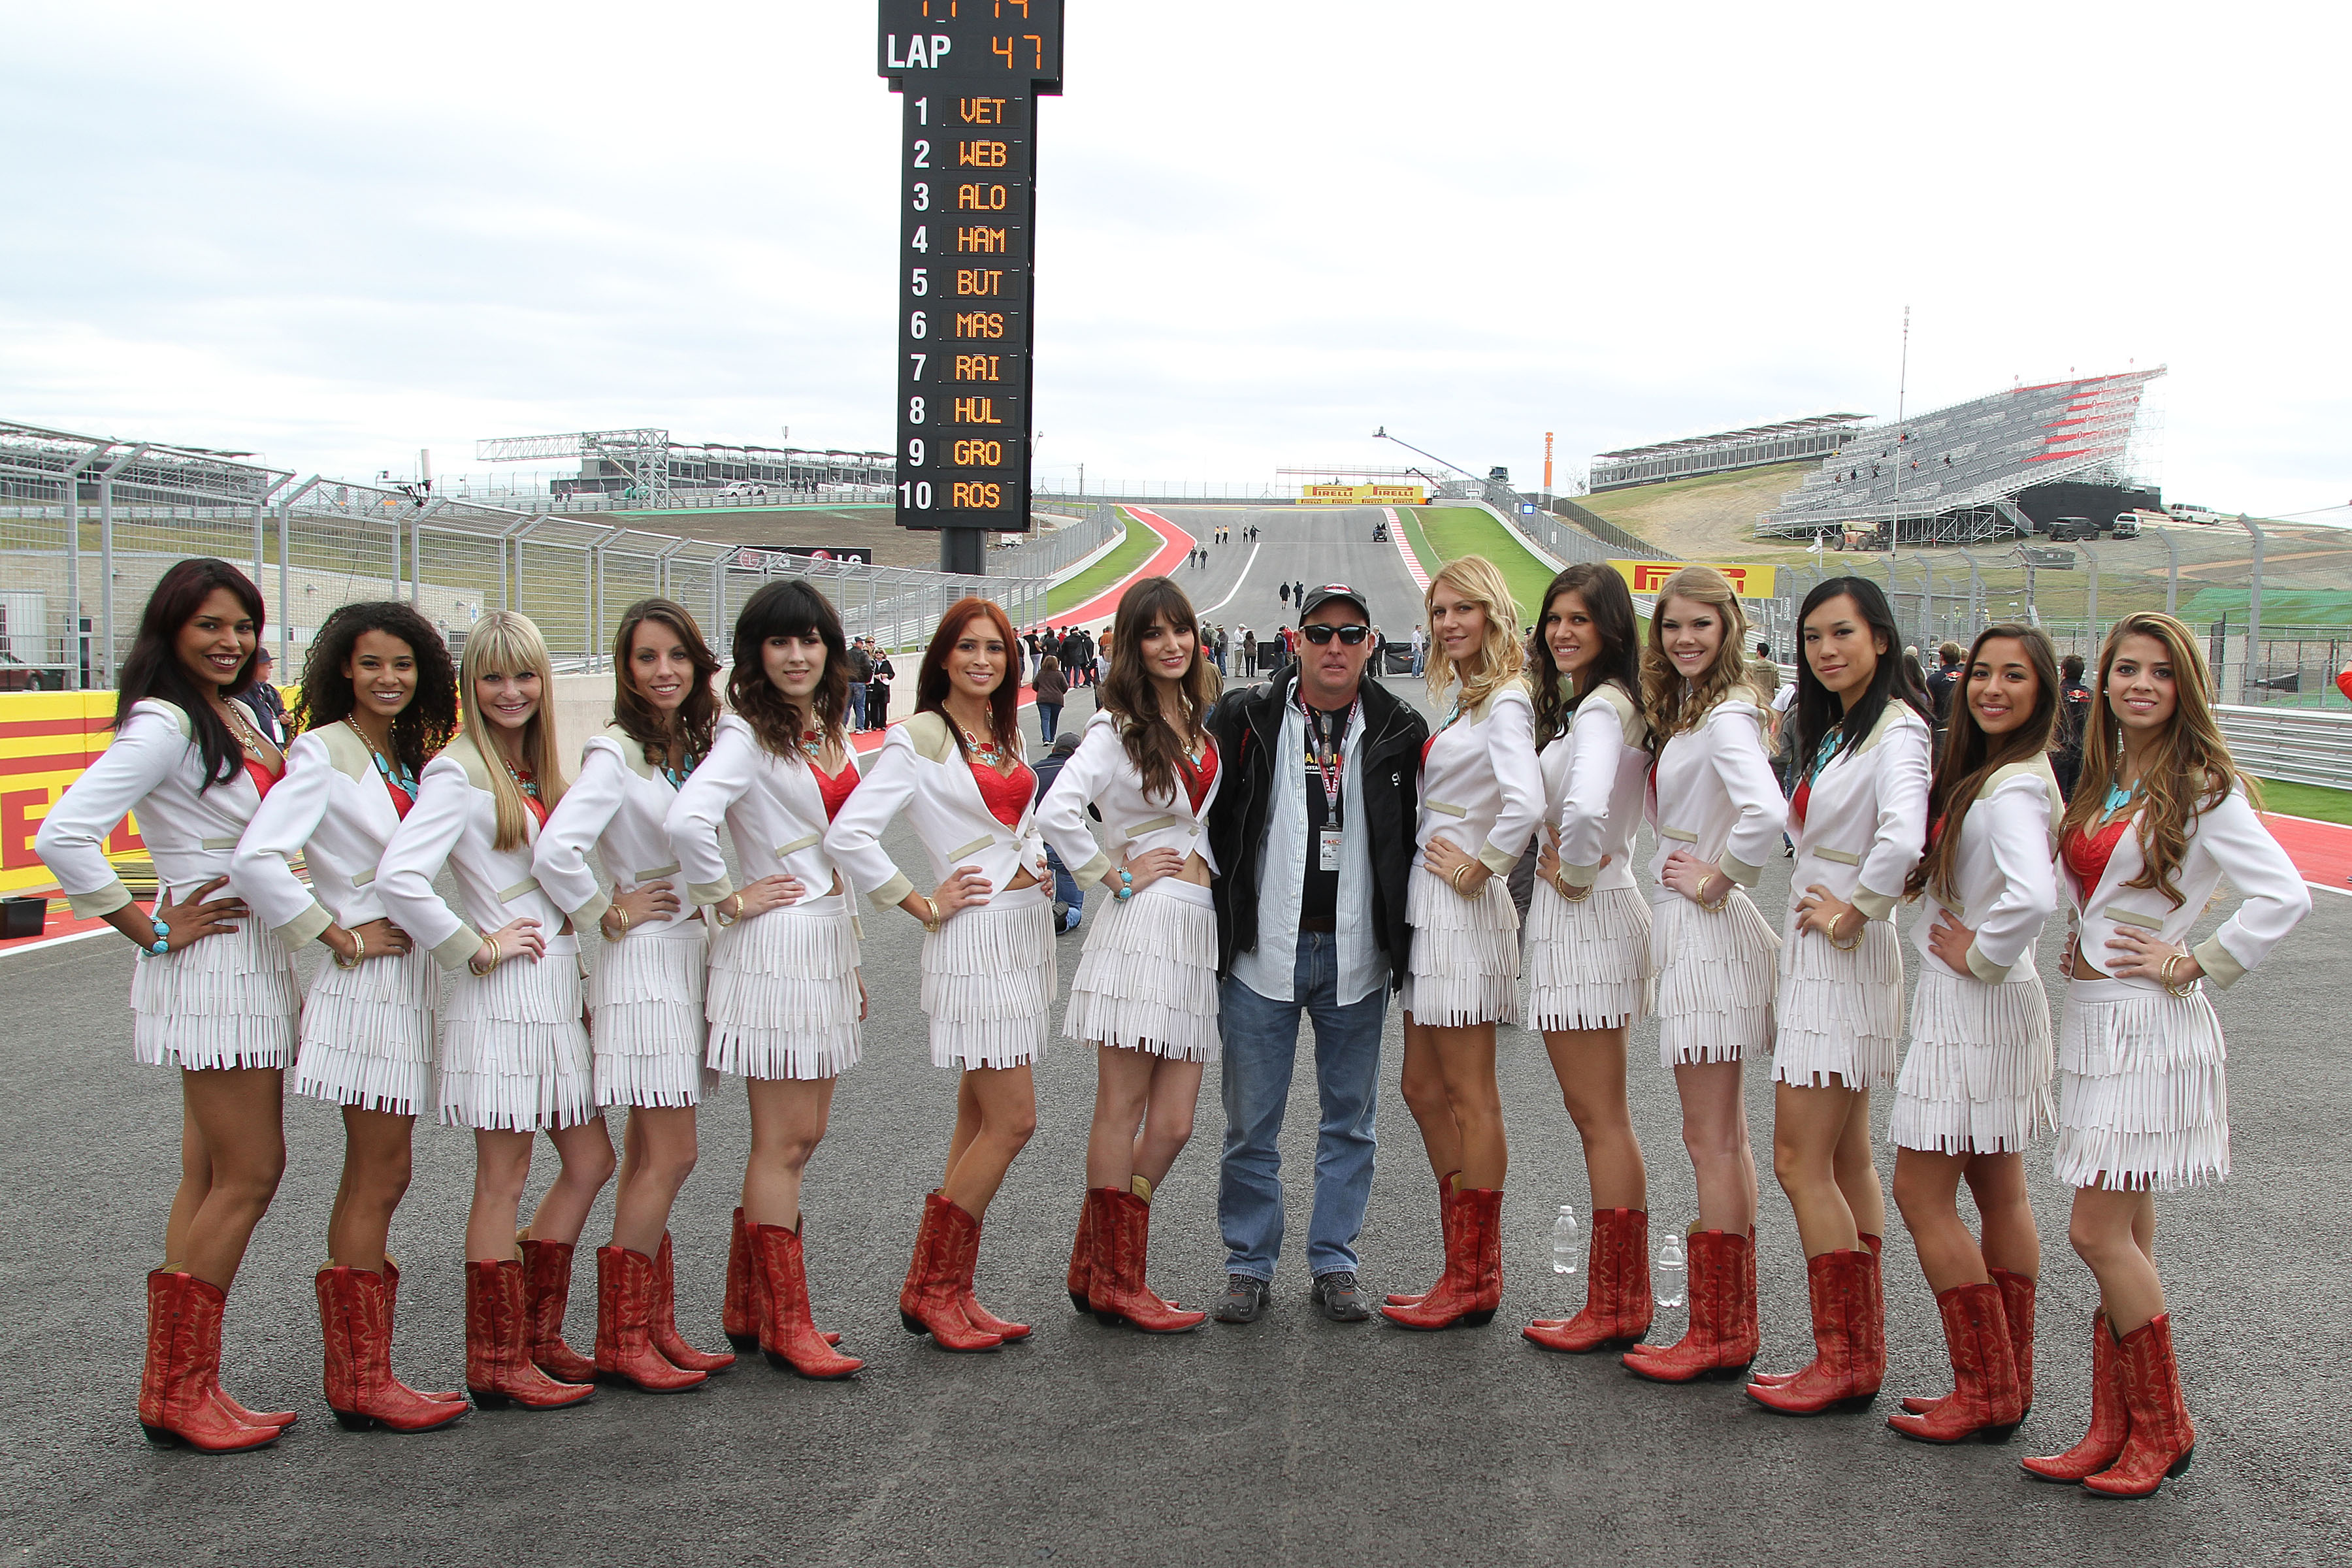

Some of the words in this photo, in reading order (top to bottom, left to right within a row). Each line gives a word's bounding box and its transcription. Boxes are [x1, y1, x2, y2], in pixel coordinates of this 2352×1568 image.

[888, 34, 951, 69] LAP
[992, 35, 1041, 69] 47
[915, 97, 926, 125] 1
[960, 98, 1005, 123] VET
[915, 140, 930, 167] 2
[960, 141, 1006, 167] WEB
[913, 183, 929, 210] 3
[959, 184, 1005, 210] ALO
[912, 226, 928, 253] 4
[958, 227, 1005, 252] HAM
[912, 269, 927, 296] 5
[958, 270, 1003, 295] BUT
[911, 312, 926, 338] 6
[956, 313, 1004, 338] MAS
[911, 354, 926, 381] 7
[956, 355, 1000, 380] RAI
[910, 397, 925, 424] 8
[955, 398, 1001, 423] HUL
[909, 439, 924, 466] 9
[955, 440, 1001, 466] GRO
[899, 482, 932, 509] 10
[953, 482, 1000, 508] ROS
[1313, 486, 1353, 497] PIRELLI
[1373, 486, 1413, 497] PIRELLI
